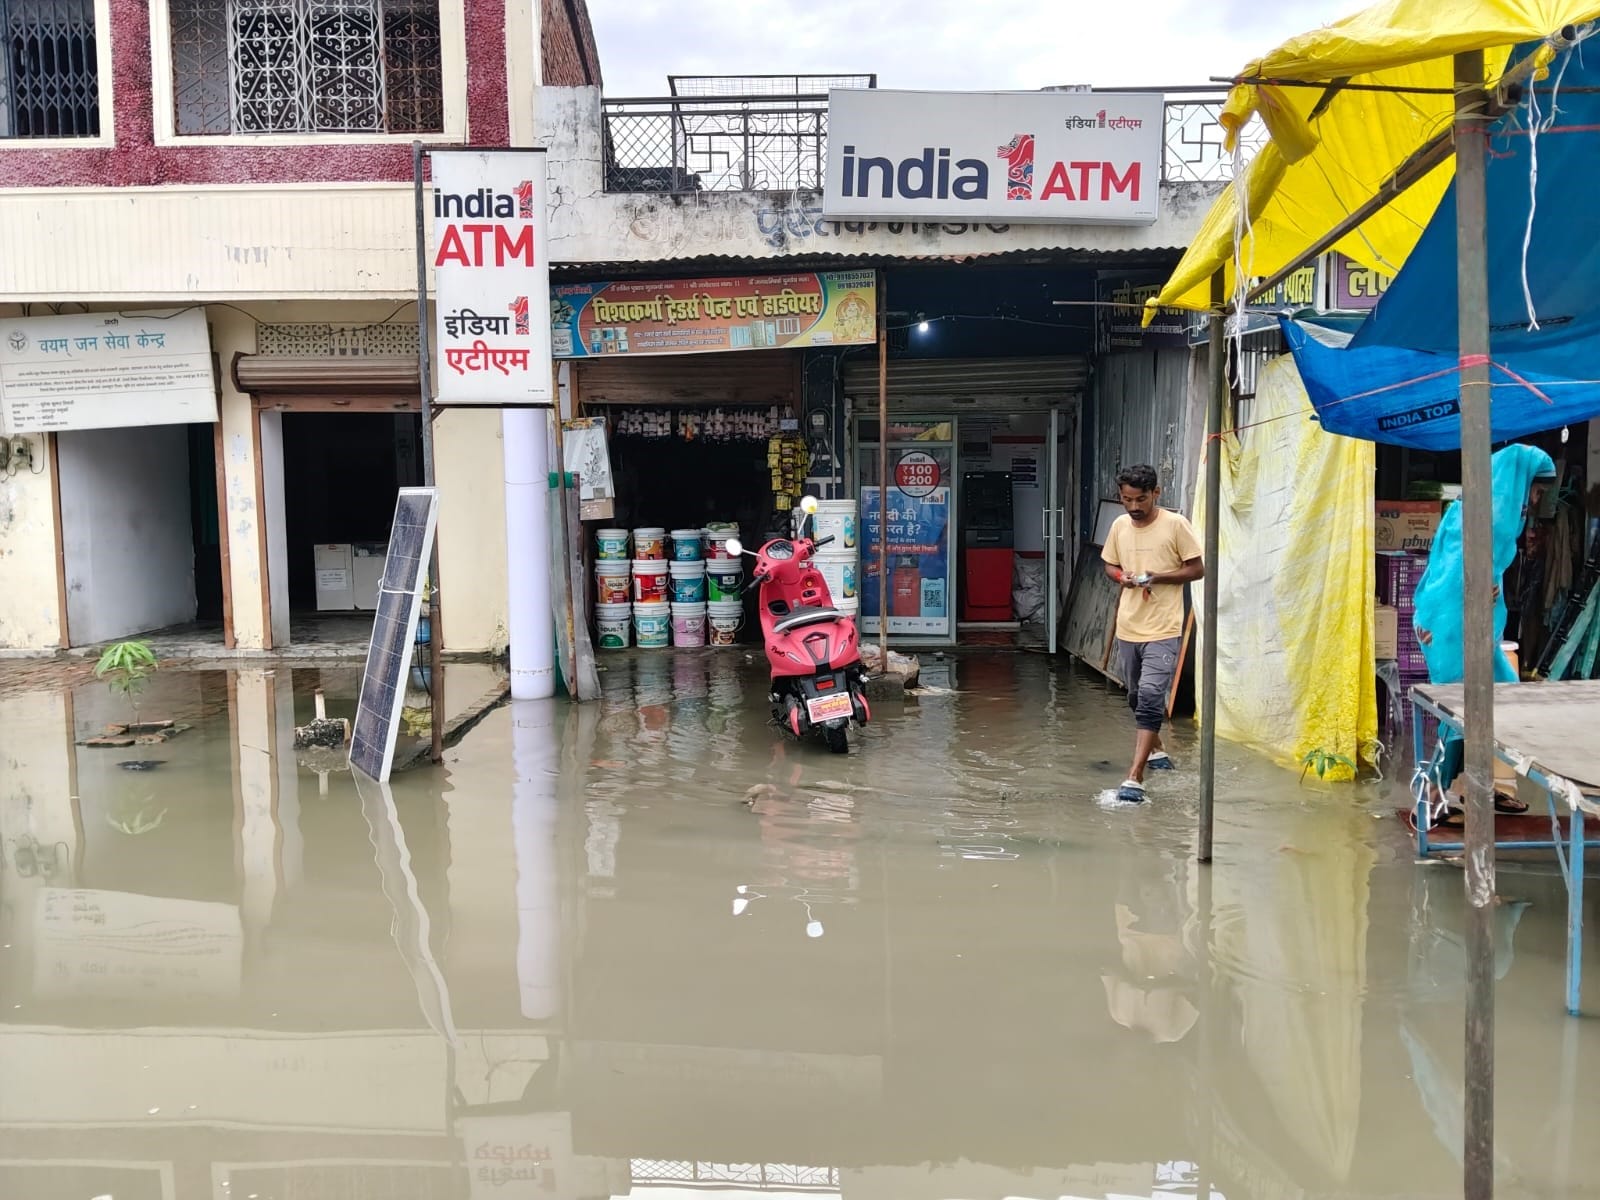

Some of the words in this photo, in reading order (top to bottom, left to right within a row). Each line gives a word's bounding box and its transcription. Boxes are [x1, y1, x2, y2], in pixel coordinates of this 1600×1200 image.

[1108, 117, 1142, 130] एटीएम
[1040, 162, 1141, 201] ATM
[435, 224, 534, 267] ATM
[592, 294, 663, 324] विश्वकर्मा
[734, 289, 760, 318] एवं
[73, 337, 98, 352] जन
[105, 331, 130, 350] सेवा
[135, 329, 166, 349] केन्द्र
[445, 340, 530, 376] एटीएम
[1382, 412, 1422, 428] INDIA
[1424, 403, 1453, 418] TOP
[902, 465, 932, 475] ₹100
[902, 476, 932, 485] ₹200
[902, 508, 917, 521] की
[907, 522, 921, 536] है?
